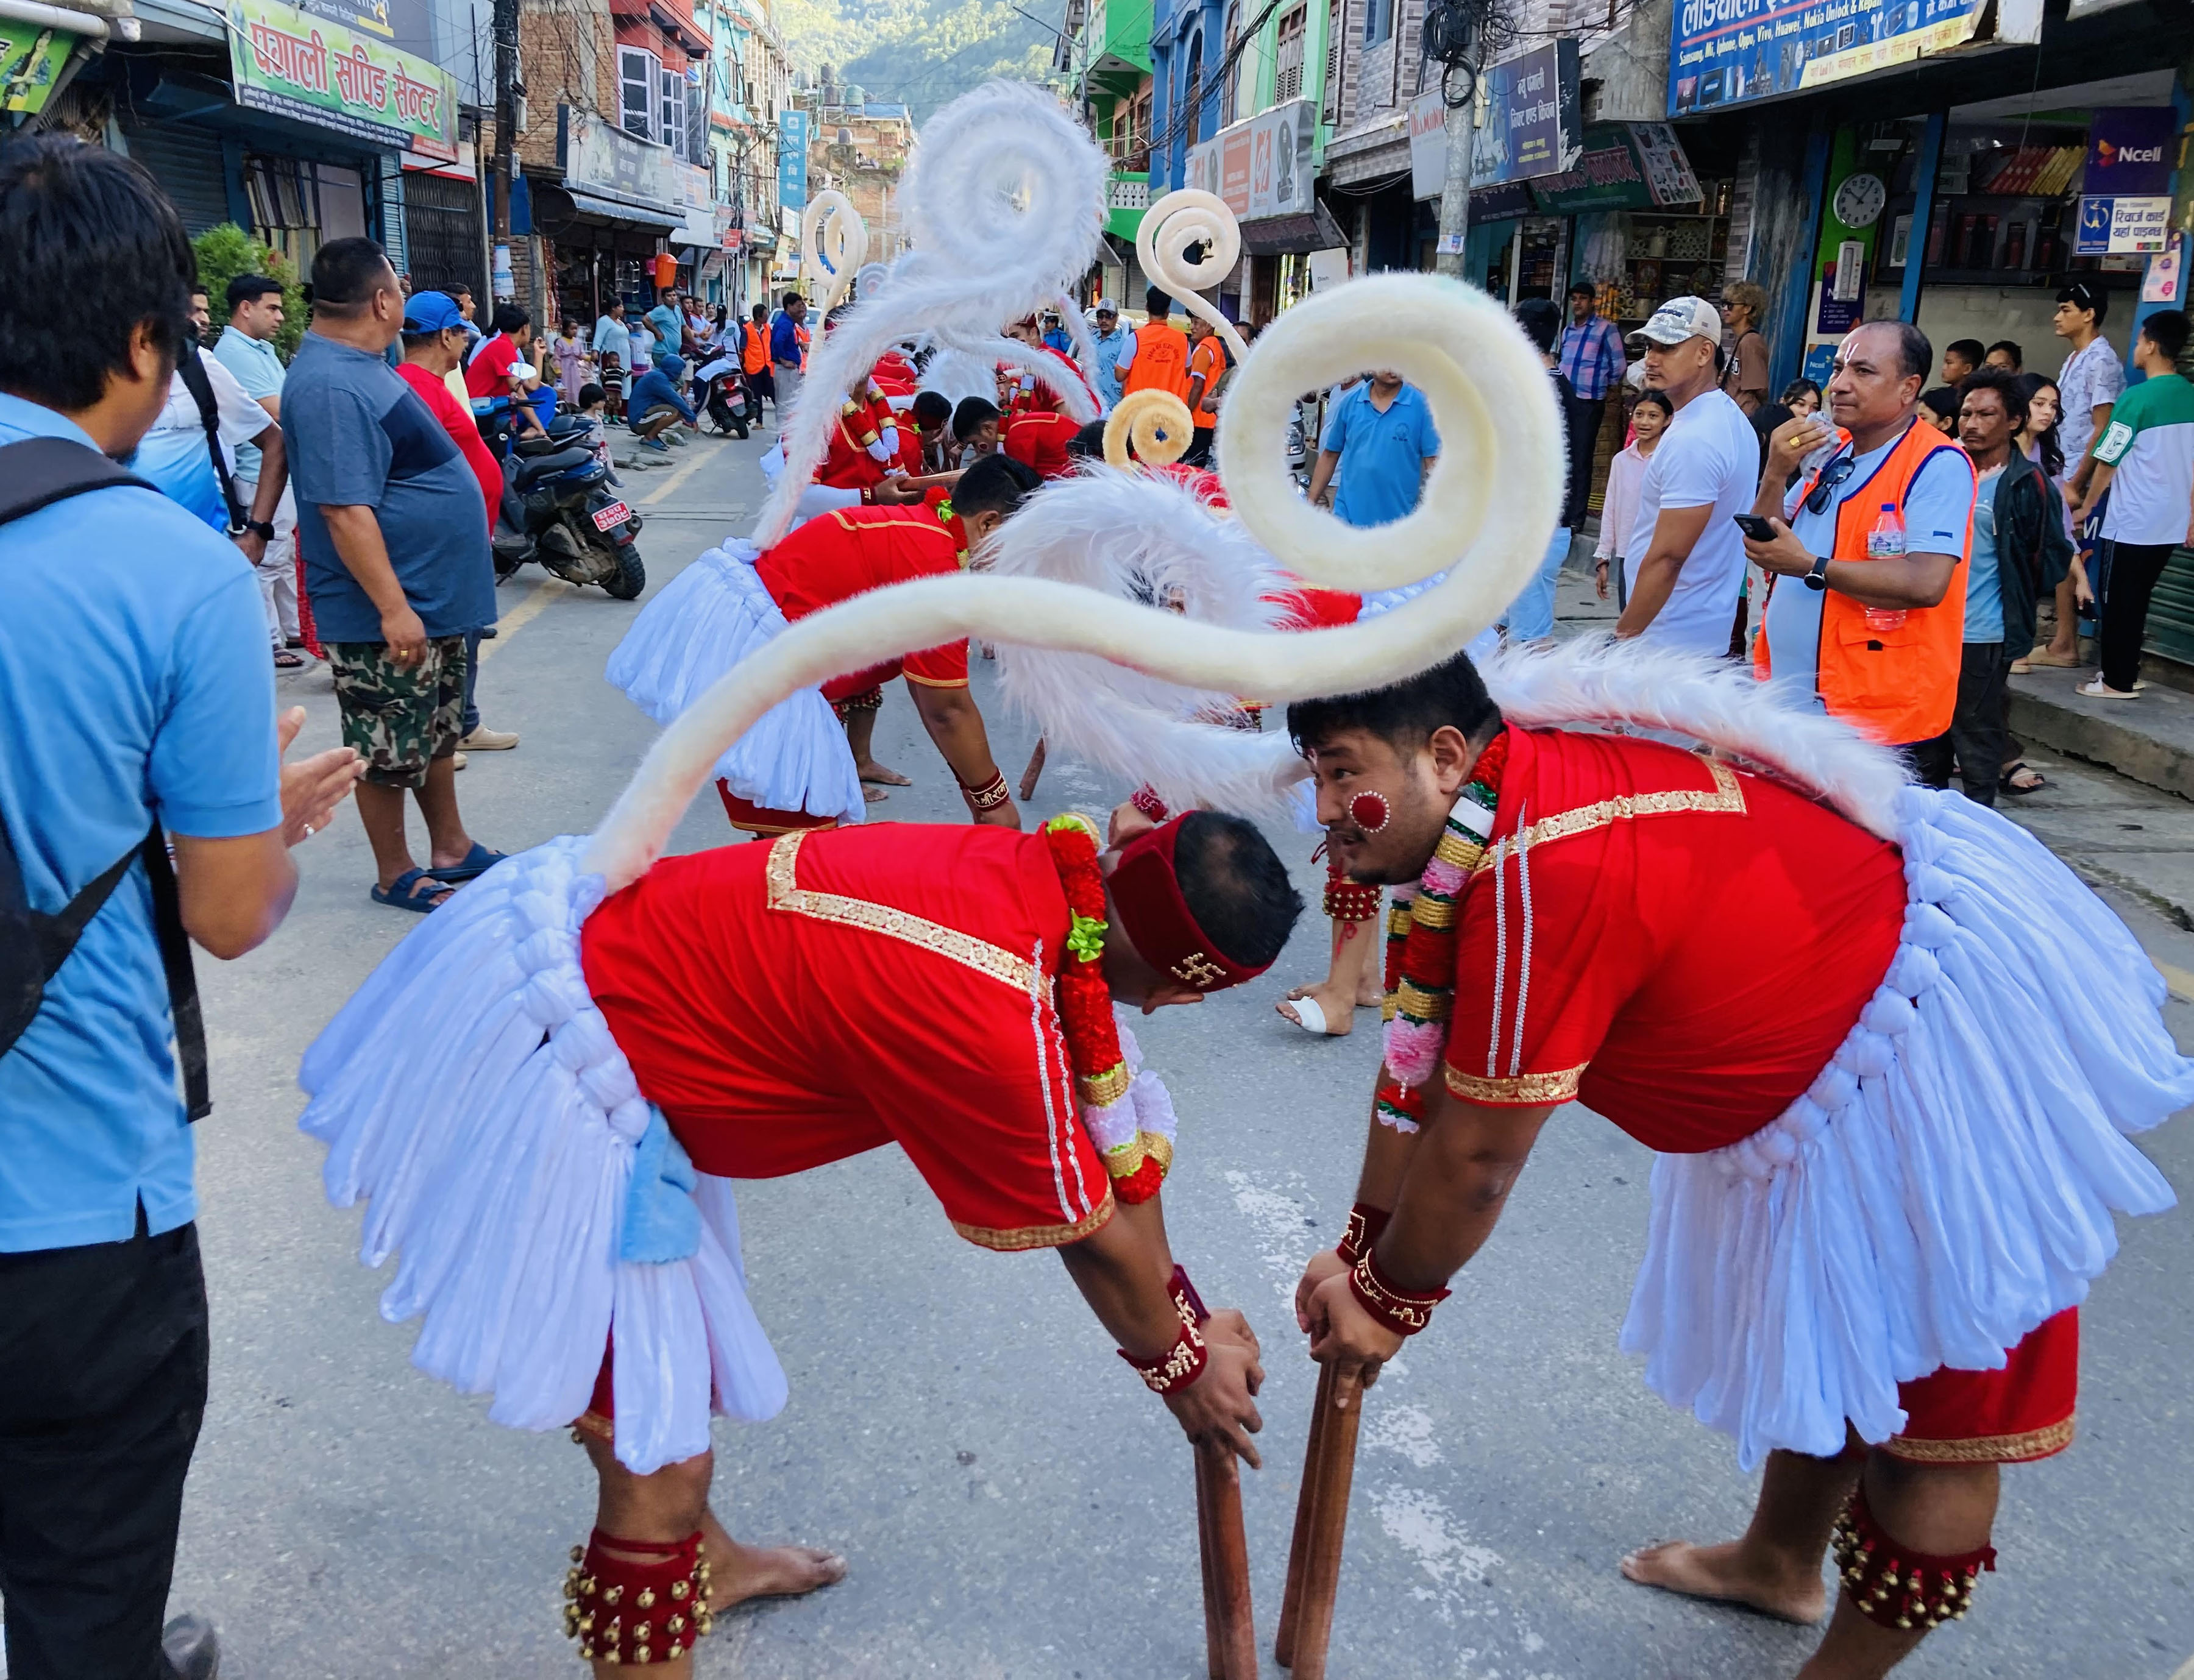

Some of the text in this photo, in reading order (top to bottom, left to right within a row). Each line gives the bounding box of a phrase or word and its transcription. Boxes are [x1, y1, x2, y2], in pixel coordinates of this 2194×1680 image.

[1679, 50, 1704, 66] Samsung,
[1705, 41, 1715, 58] Mi,
[1717, 37, 1737, 57] Iphone,
[1739, 32, 1755, 50] Oppo,
[1757, 25, 1773, 43] Vivo,
[1775, 15, 1802, 37] Huawei,
[1804, 9, 1824, 29] Nokia
[1826, 0, 1848, 23] Unlock
[1850, 2, 1857, 14] &
[2118, 146, 2163, 163] Ncell
